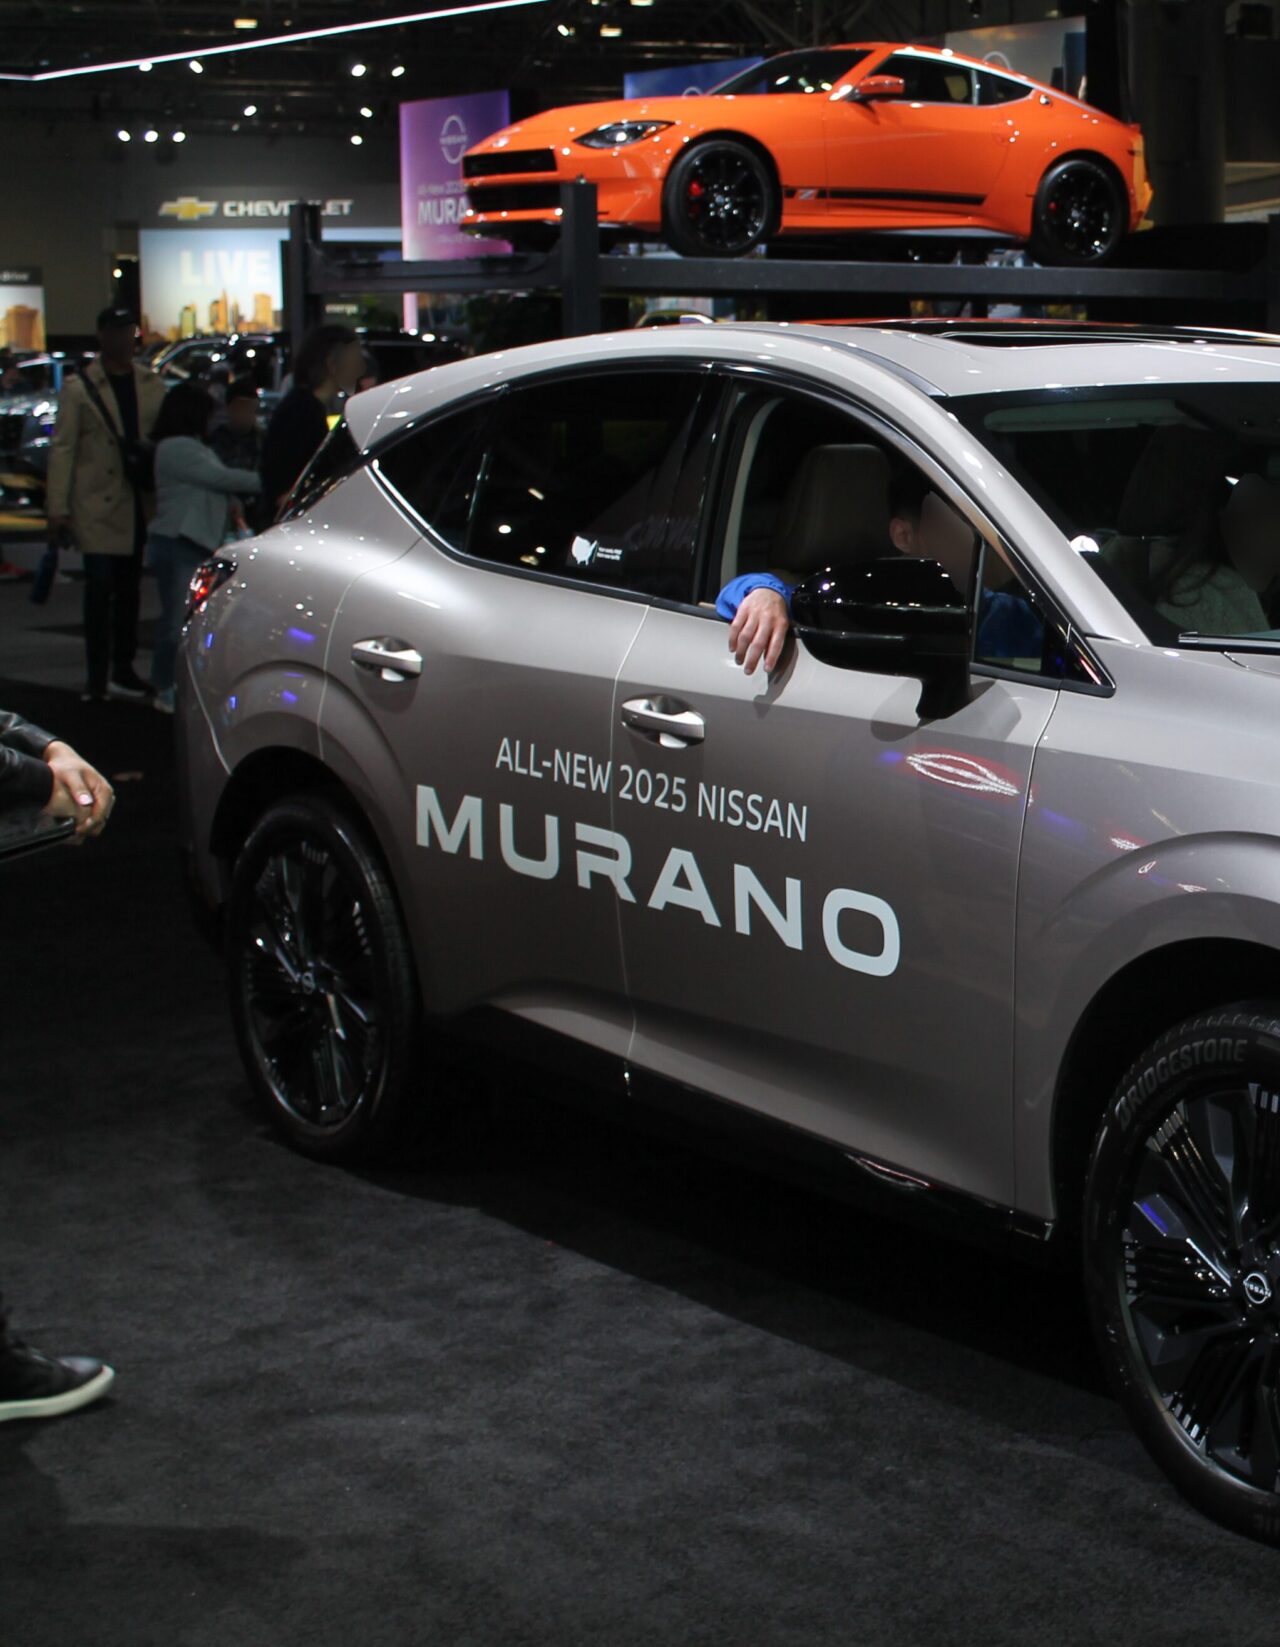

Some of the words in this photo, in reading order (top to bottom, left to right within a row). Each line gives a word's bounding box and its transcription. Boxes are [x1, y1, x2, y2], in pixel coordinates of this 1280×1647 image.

[418, 197, 468, 225] MURA
[180, 250, 272, 287] LIVE
[495, 737, 611, 794] ALL-NEW
[619, 765, 686, 812] 2025
[698, 783, 807, 842] NISSAN
[416, 784, 900, 977] MURANO
